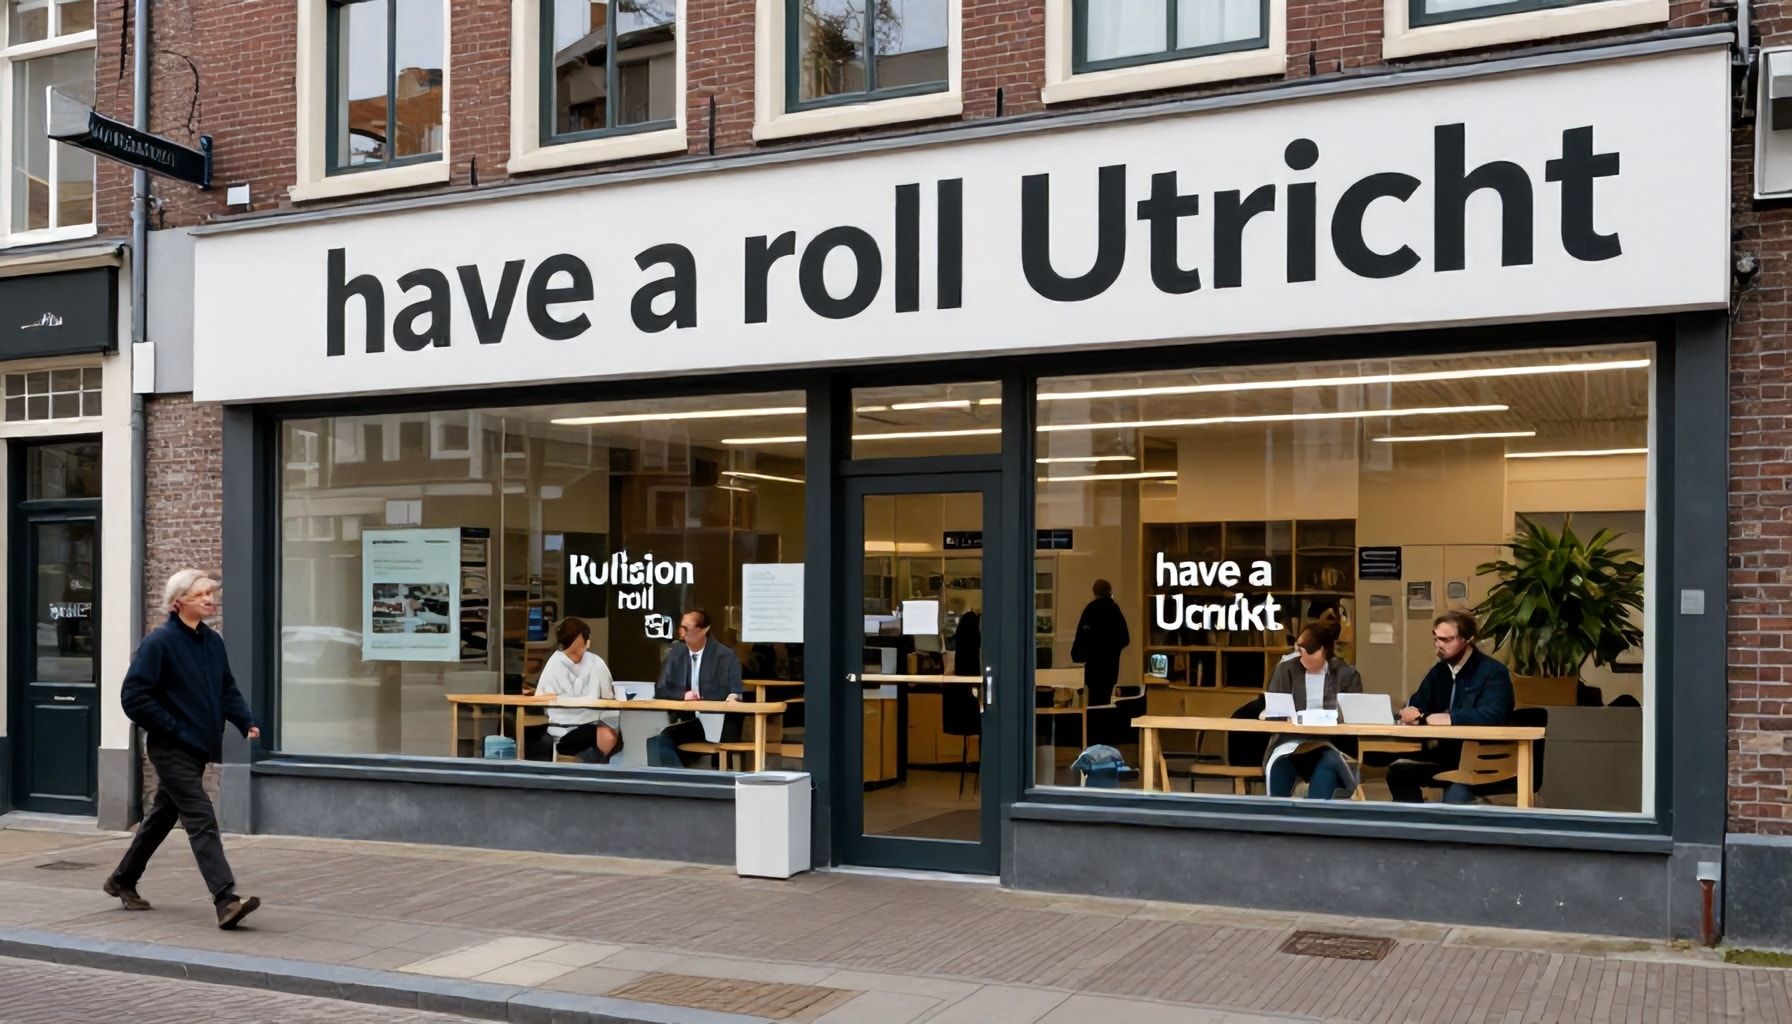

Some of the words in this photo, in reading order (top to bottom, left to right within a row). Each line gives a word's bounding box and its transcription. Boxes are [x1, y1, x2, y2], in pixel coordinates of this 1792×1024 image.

[326, 247, 594, 357] have
[631, 242, 698, 334] a
[744, 177, 963, 325] roll
[1021, 122, 1623, 302] Utricht
[1156, 551, 1242, 588] have
[1248, 560, 1272, 587] a
[618, 586, 654, 611] roll
